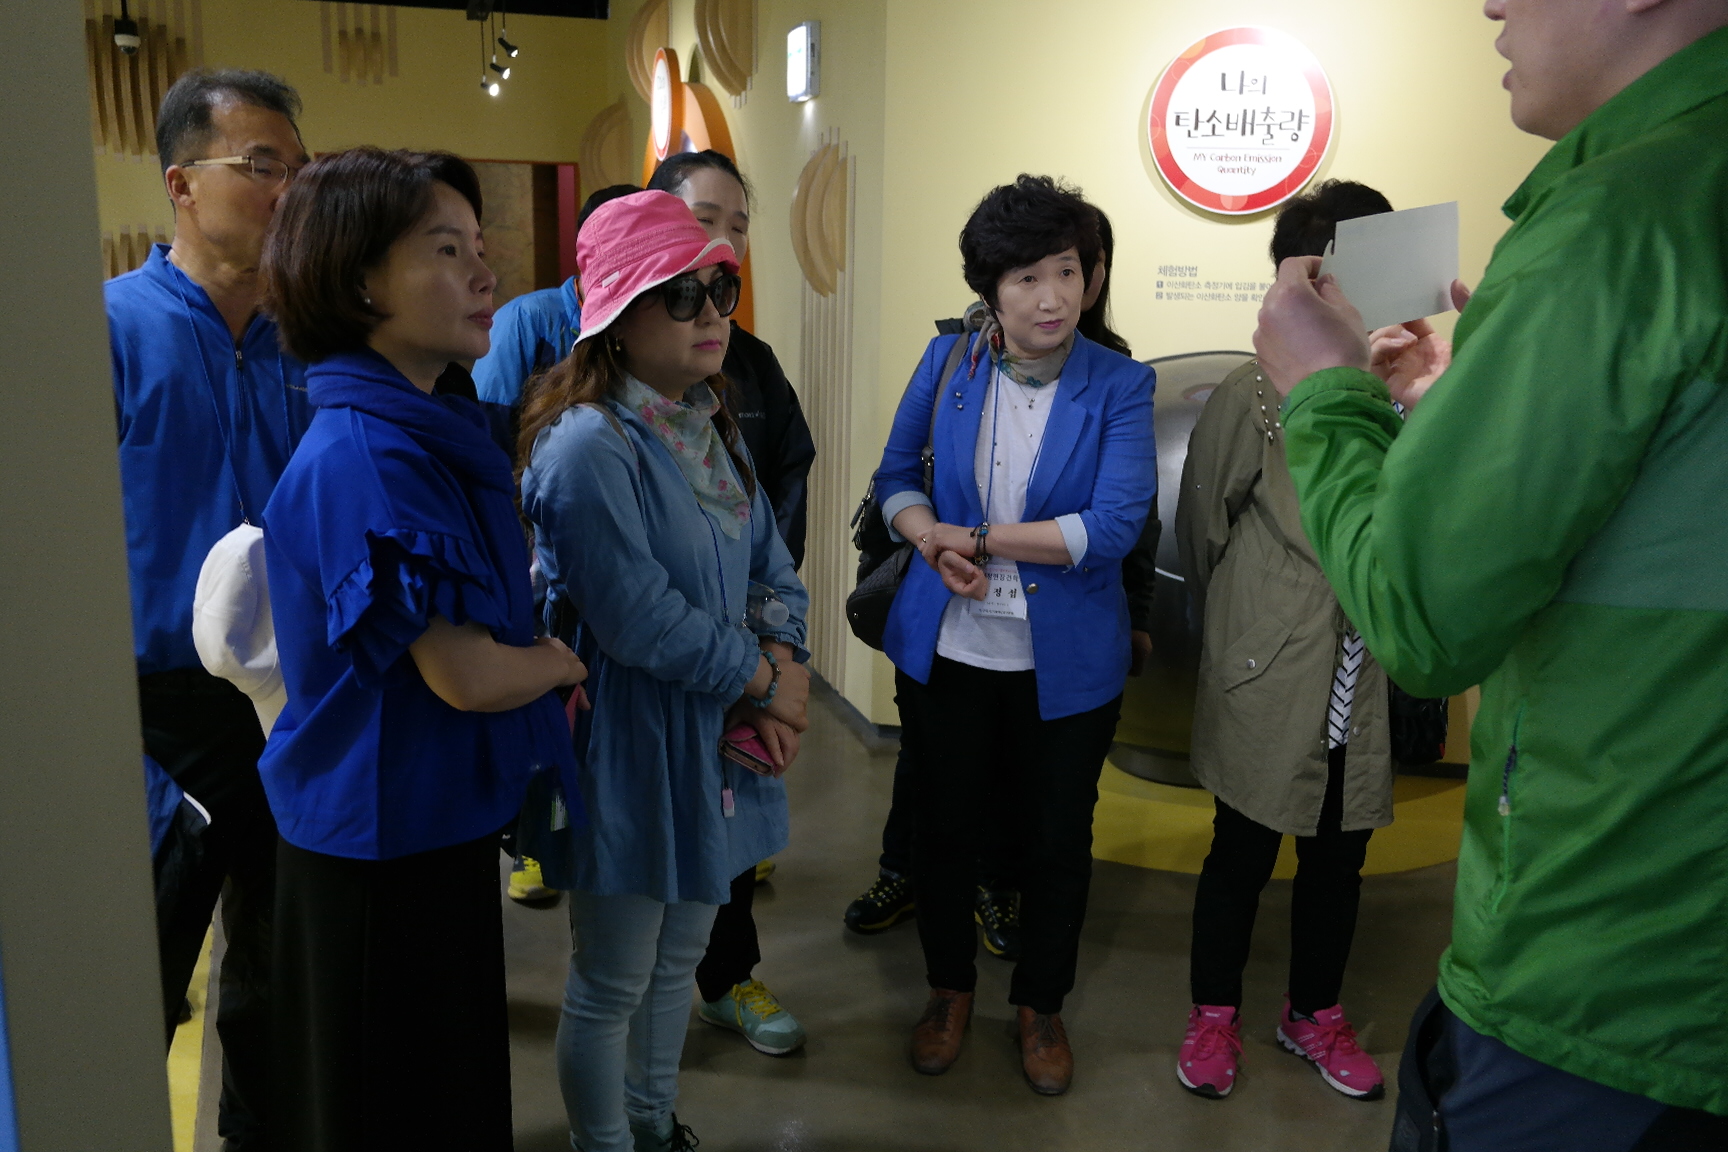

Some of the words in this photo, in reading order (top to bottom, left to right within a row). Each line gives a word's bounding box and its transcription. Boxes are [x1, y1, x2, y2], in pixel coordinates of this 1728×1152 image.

[1220, 70, 1267, 95] 나의
[1174, 106, 1310, 145] 탄소배출량
[1193, 153, 1207, 161] MY
[1209, 153, 1242, 162] Carbon
[1243, 153, 1282, 163] Emission
[1217, 165, 1257, 176] Quantity
[1157, 265, 1198, 277] 체험방법
[1166, 281, 1202, 290] 이산화탄소
[1196, 292, 1231, 301] 이산화탄소
